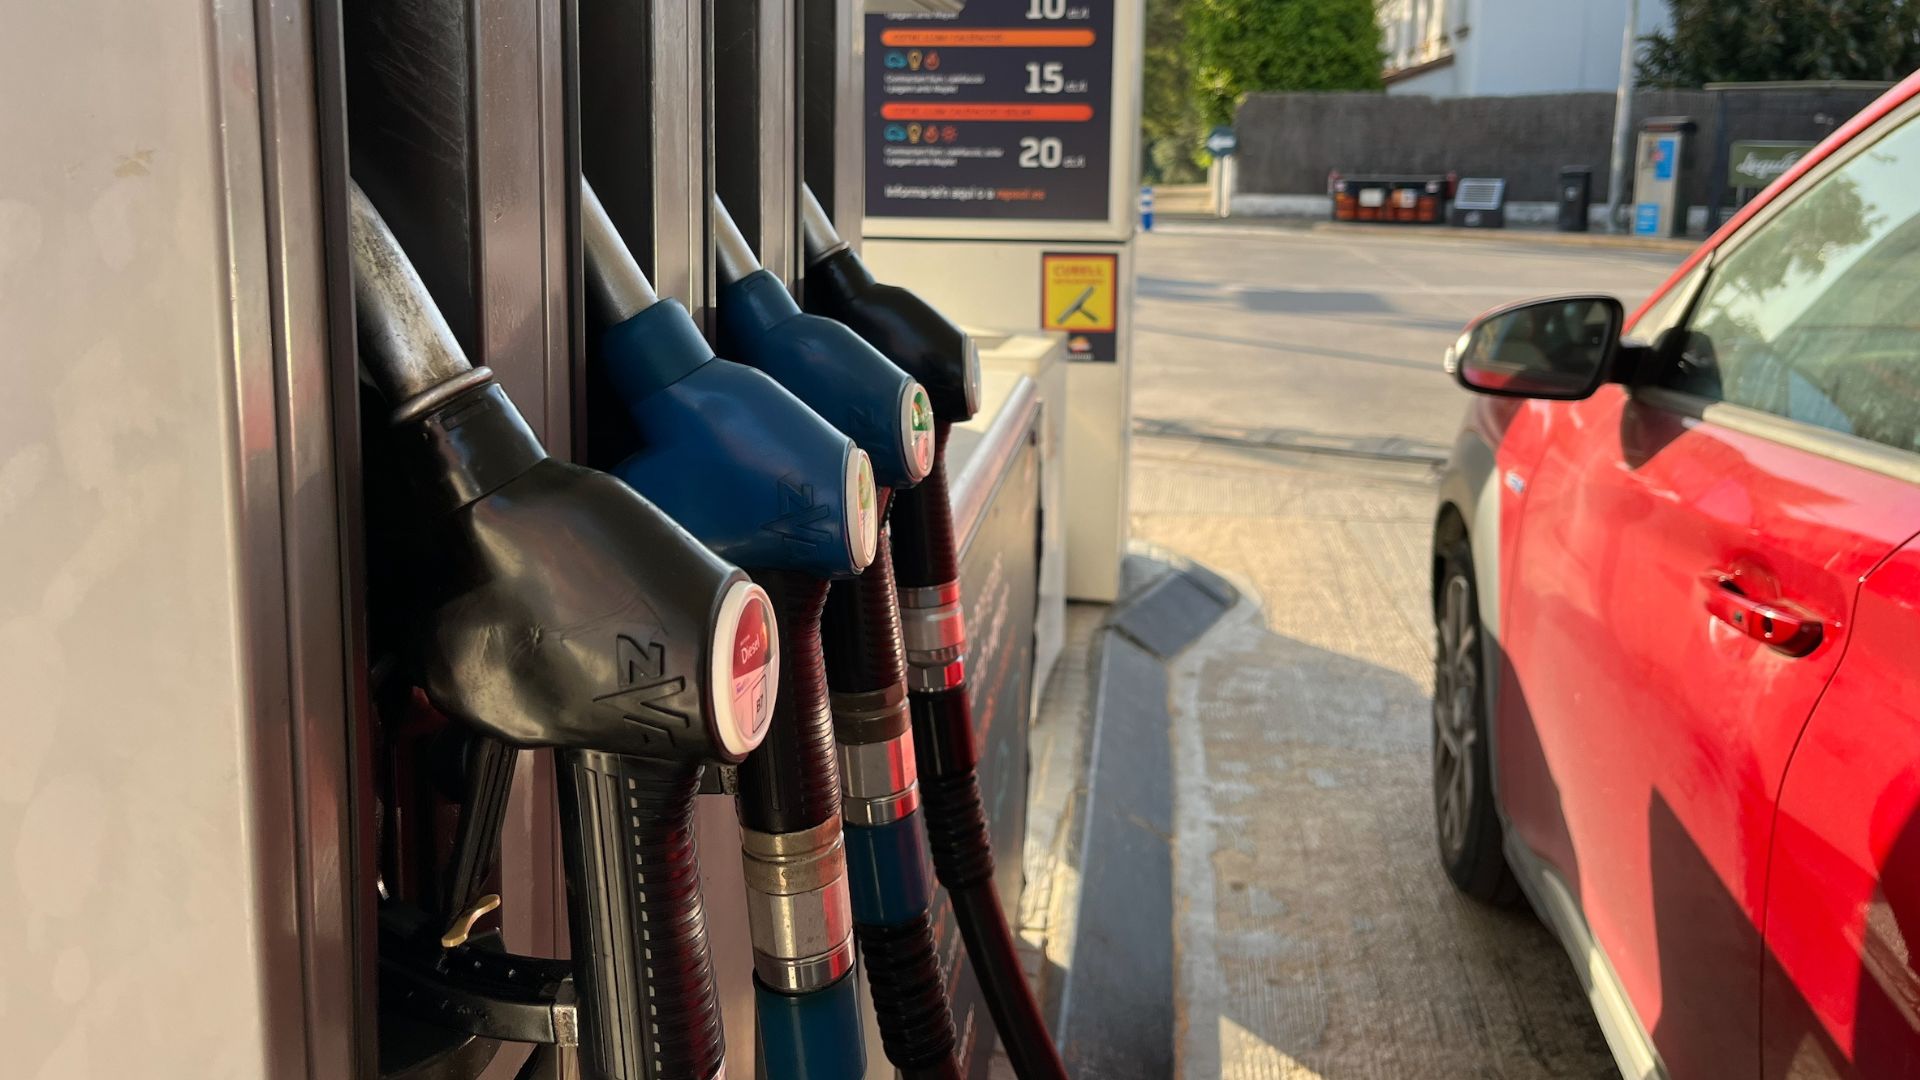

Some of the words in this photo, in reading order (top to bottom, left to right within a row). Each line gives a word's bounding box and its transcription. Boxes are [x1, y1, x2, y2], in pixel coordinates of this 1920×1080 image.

[1025, 0, 1066, 19] 10
[1025, 62, 1065, 93] 15
[1018, 137, 1063, 168] 20
[740, 636, 761, 665] Diesel
